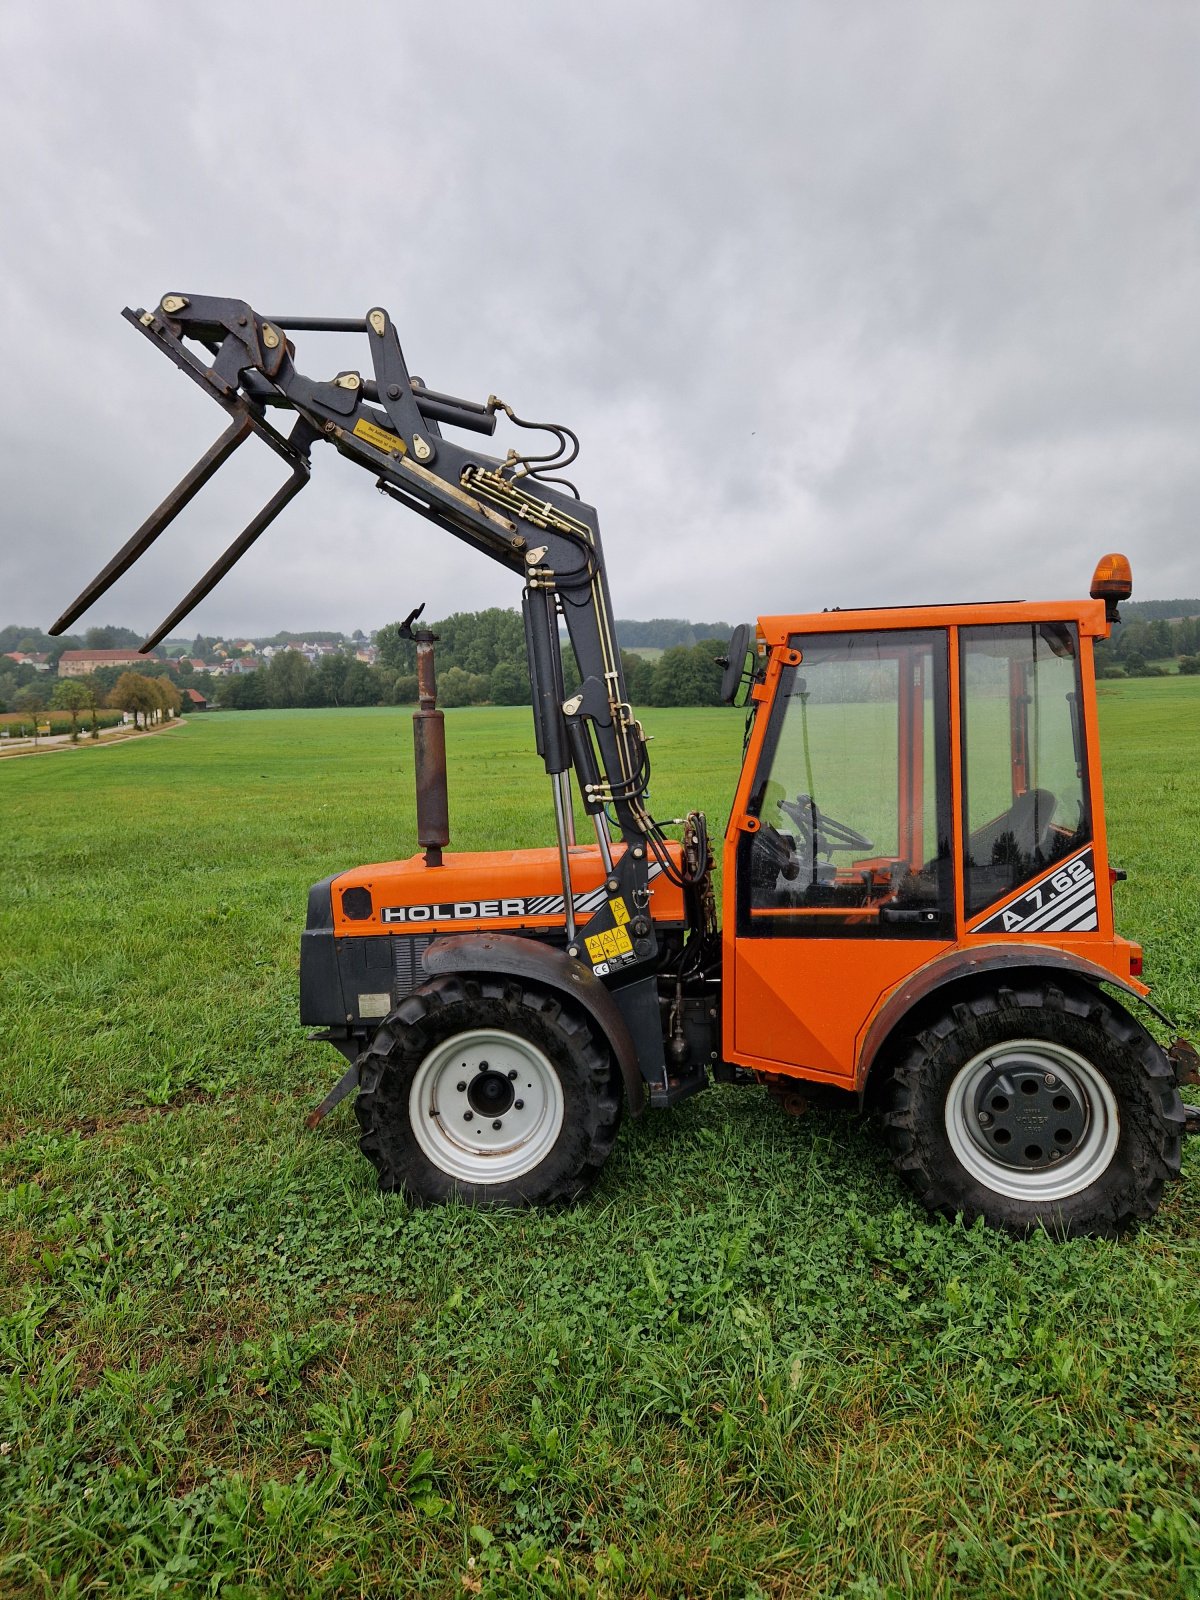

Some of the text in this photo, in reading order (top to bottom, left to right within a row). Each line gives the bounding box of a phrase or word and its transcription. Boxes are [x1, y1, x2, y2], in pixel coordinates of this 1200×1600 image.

[1002, 860, 1091, 931] A 7.62
[385, 899, 525, 921] HOLDER
[595, 964, 608, 975] CE
